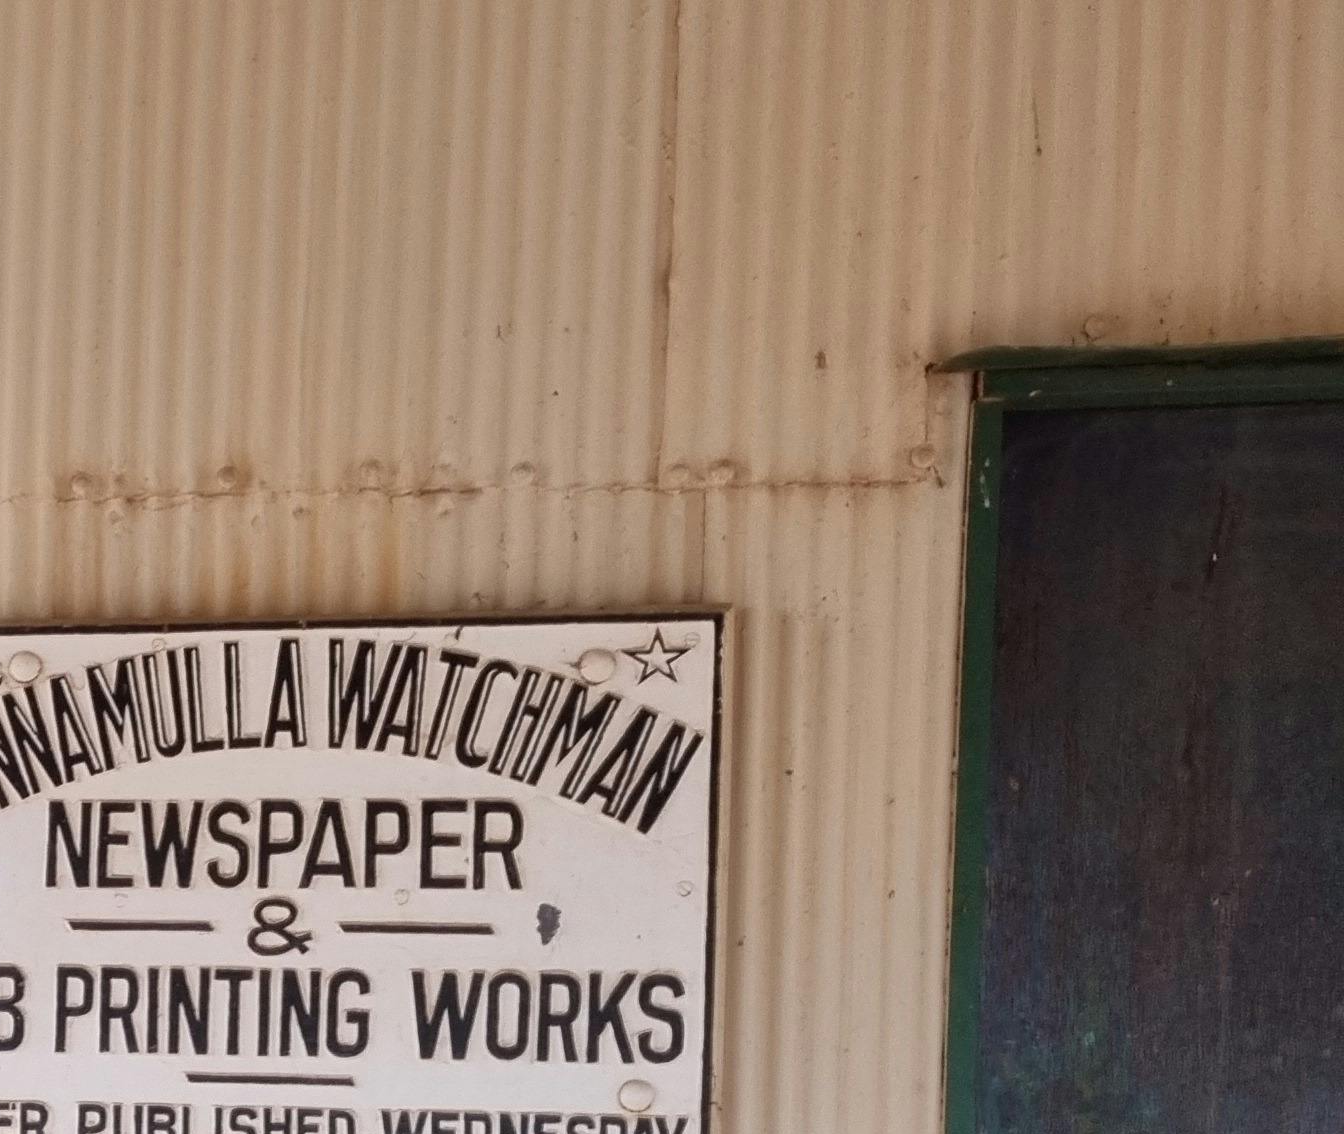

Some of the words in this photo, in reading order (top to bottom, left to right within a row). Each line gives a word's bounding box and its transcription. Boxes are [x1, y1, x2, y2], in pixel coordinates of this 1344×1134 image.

[326, 638, 705, 836] WATCHMAN
[45, 799, 526, 891] NEWSPAPER
[246, 897, 312, 957] &
[54, 967, 372, 1058] PRINTING
[412, 971, 687, 1065] WORKS
